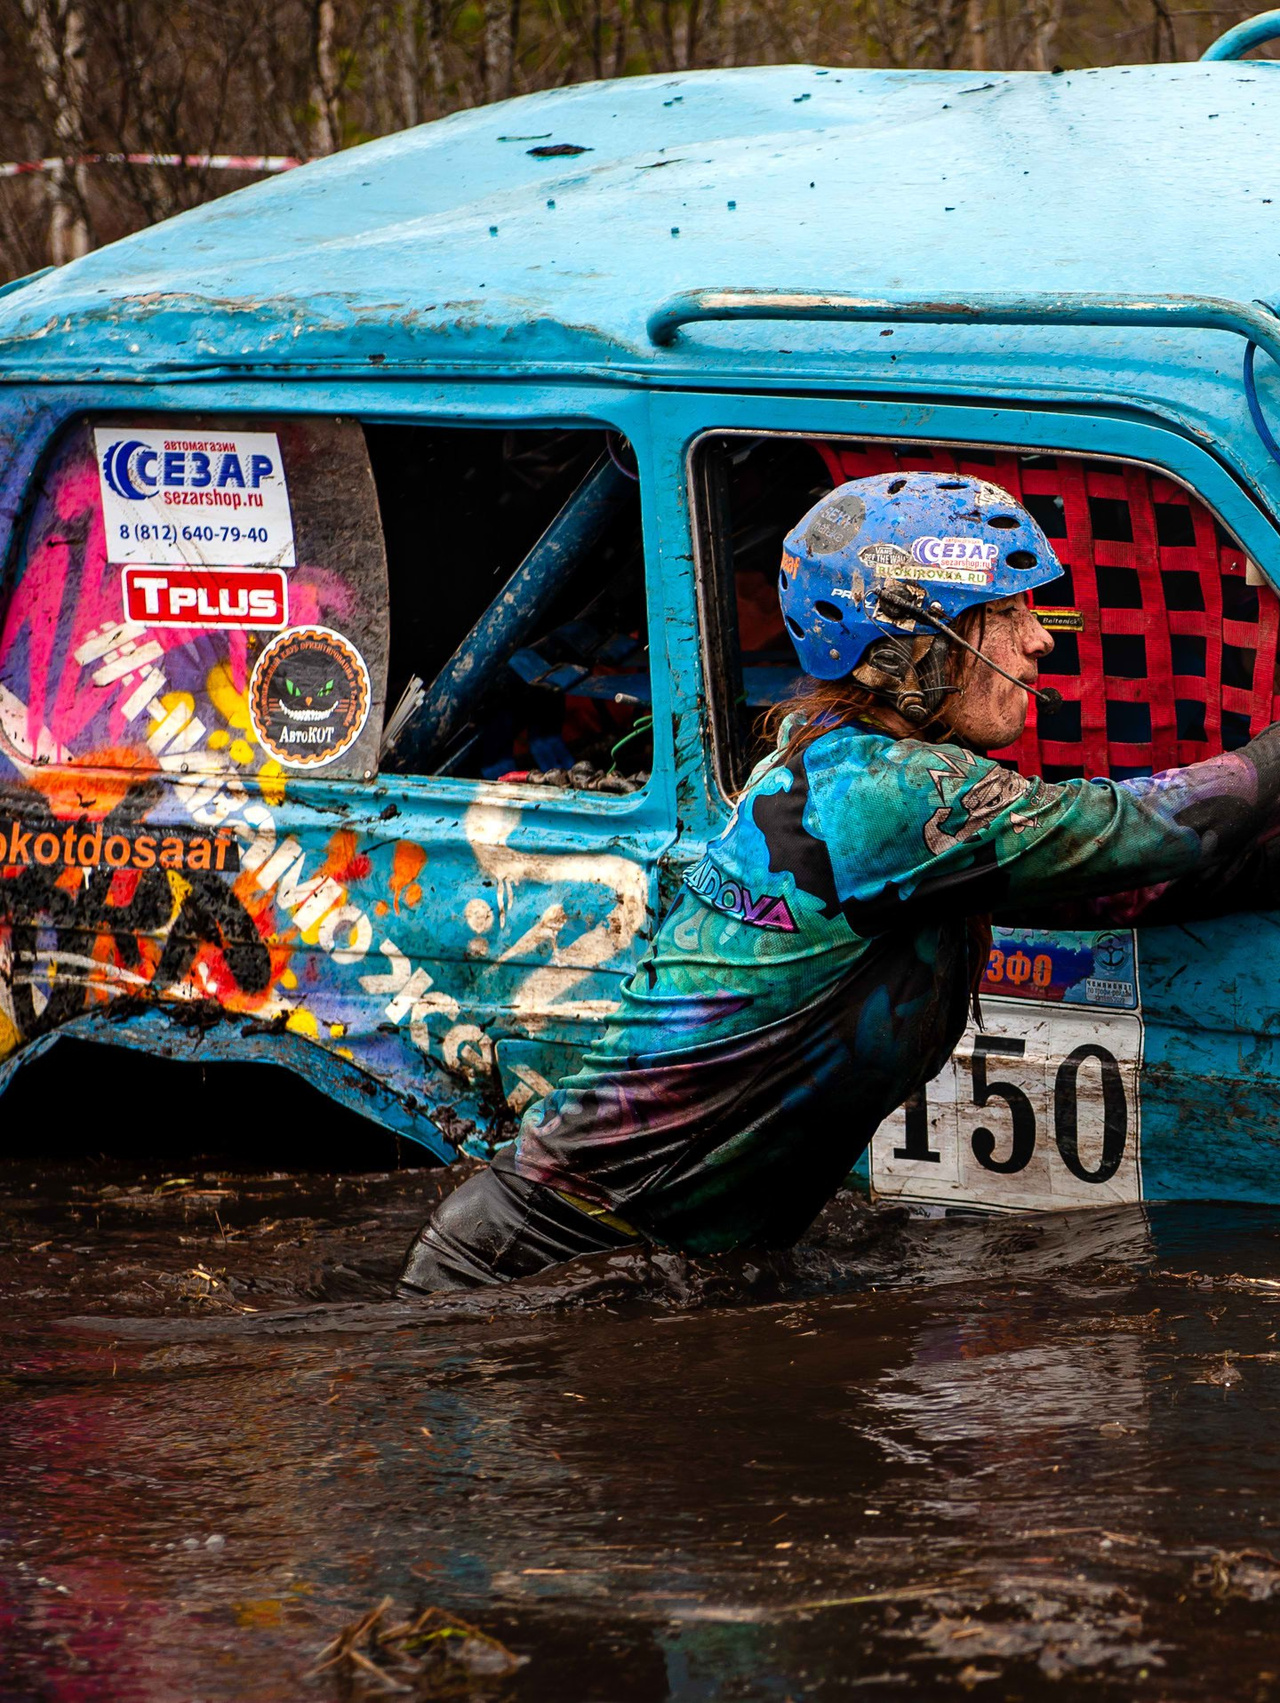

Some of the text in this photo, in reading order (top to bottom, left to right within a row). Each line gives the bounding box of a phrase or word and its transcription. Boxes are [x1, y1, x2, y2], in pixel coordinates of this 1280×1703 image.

[163, 440, 236, 452] автомагазин
[135, 450, 274, 489] СЕЗАР
[163, 489, 263, 510] sezarshop.ru
[119, 523, 268, 544] 8 (812) 640-79-40
[930, 543, 997, 560] СЕЗАР
[0, 821, 233, 871] kotdosaaf
[893, 1034, 1128, 1184] 150
